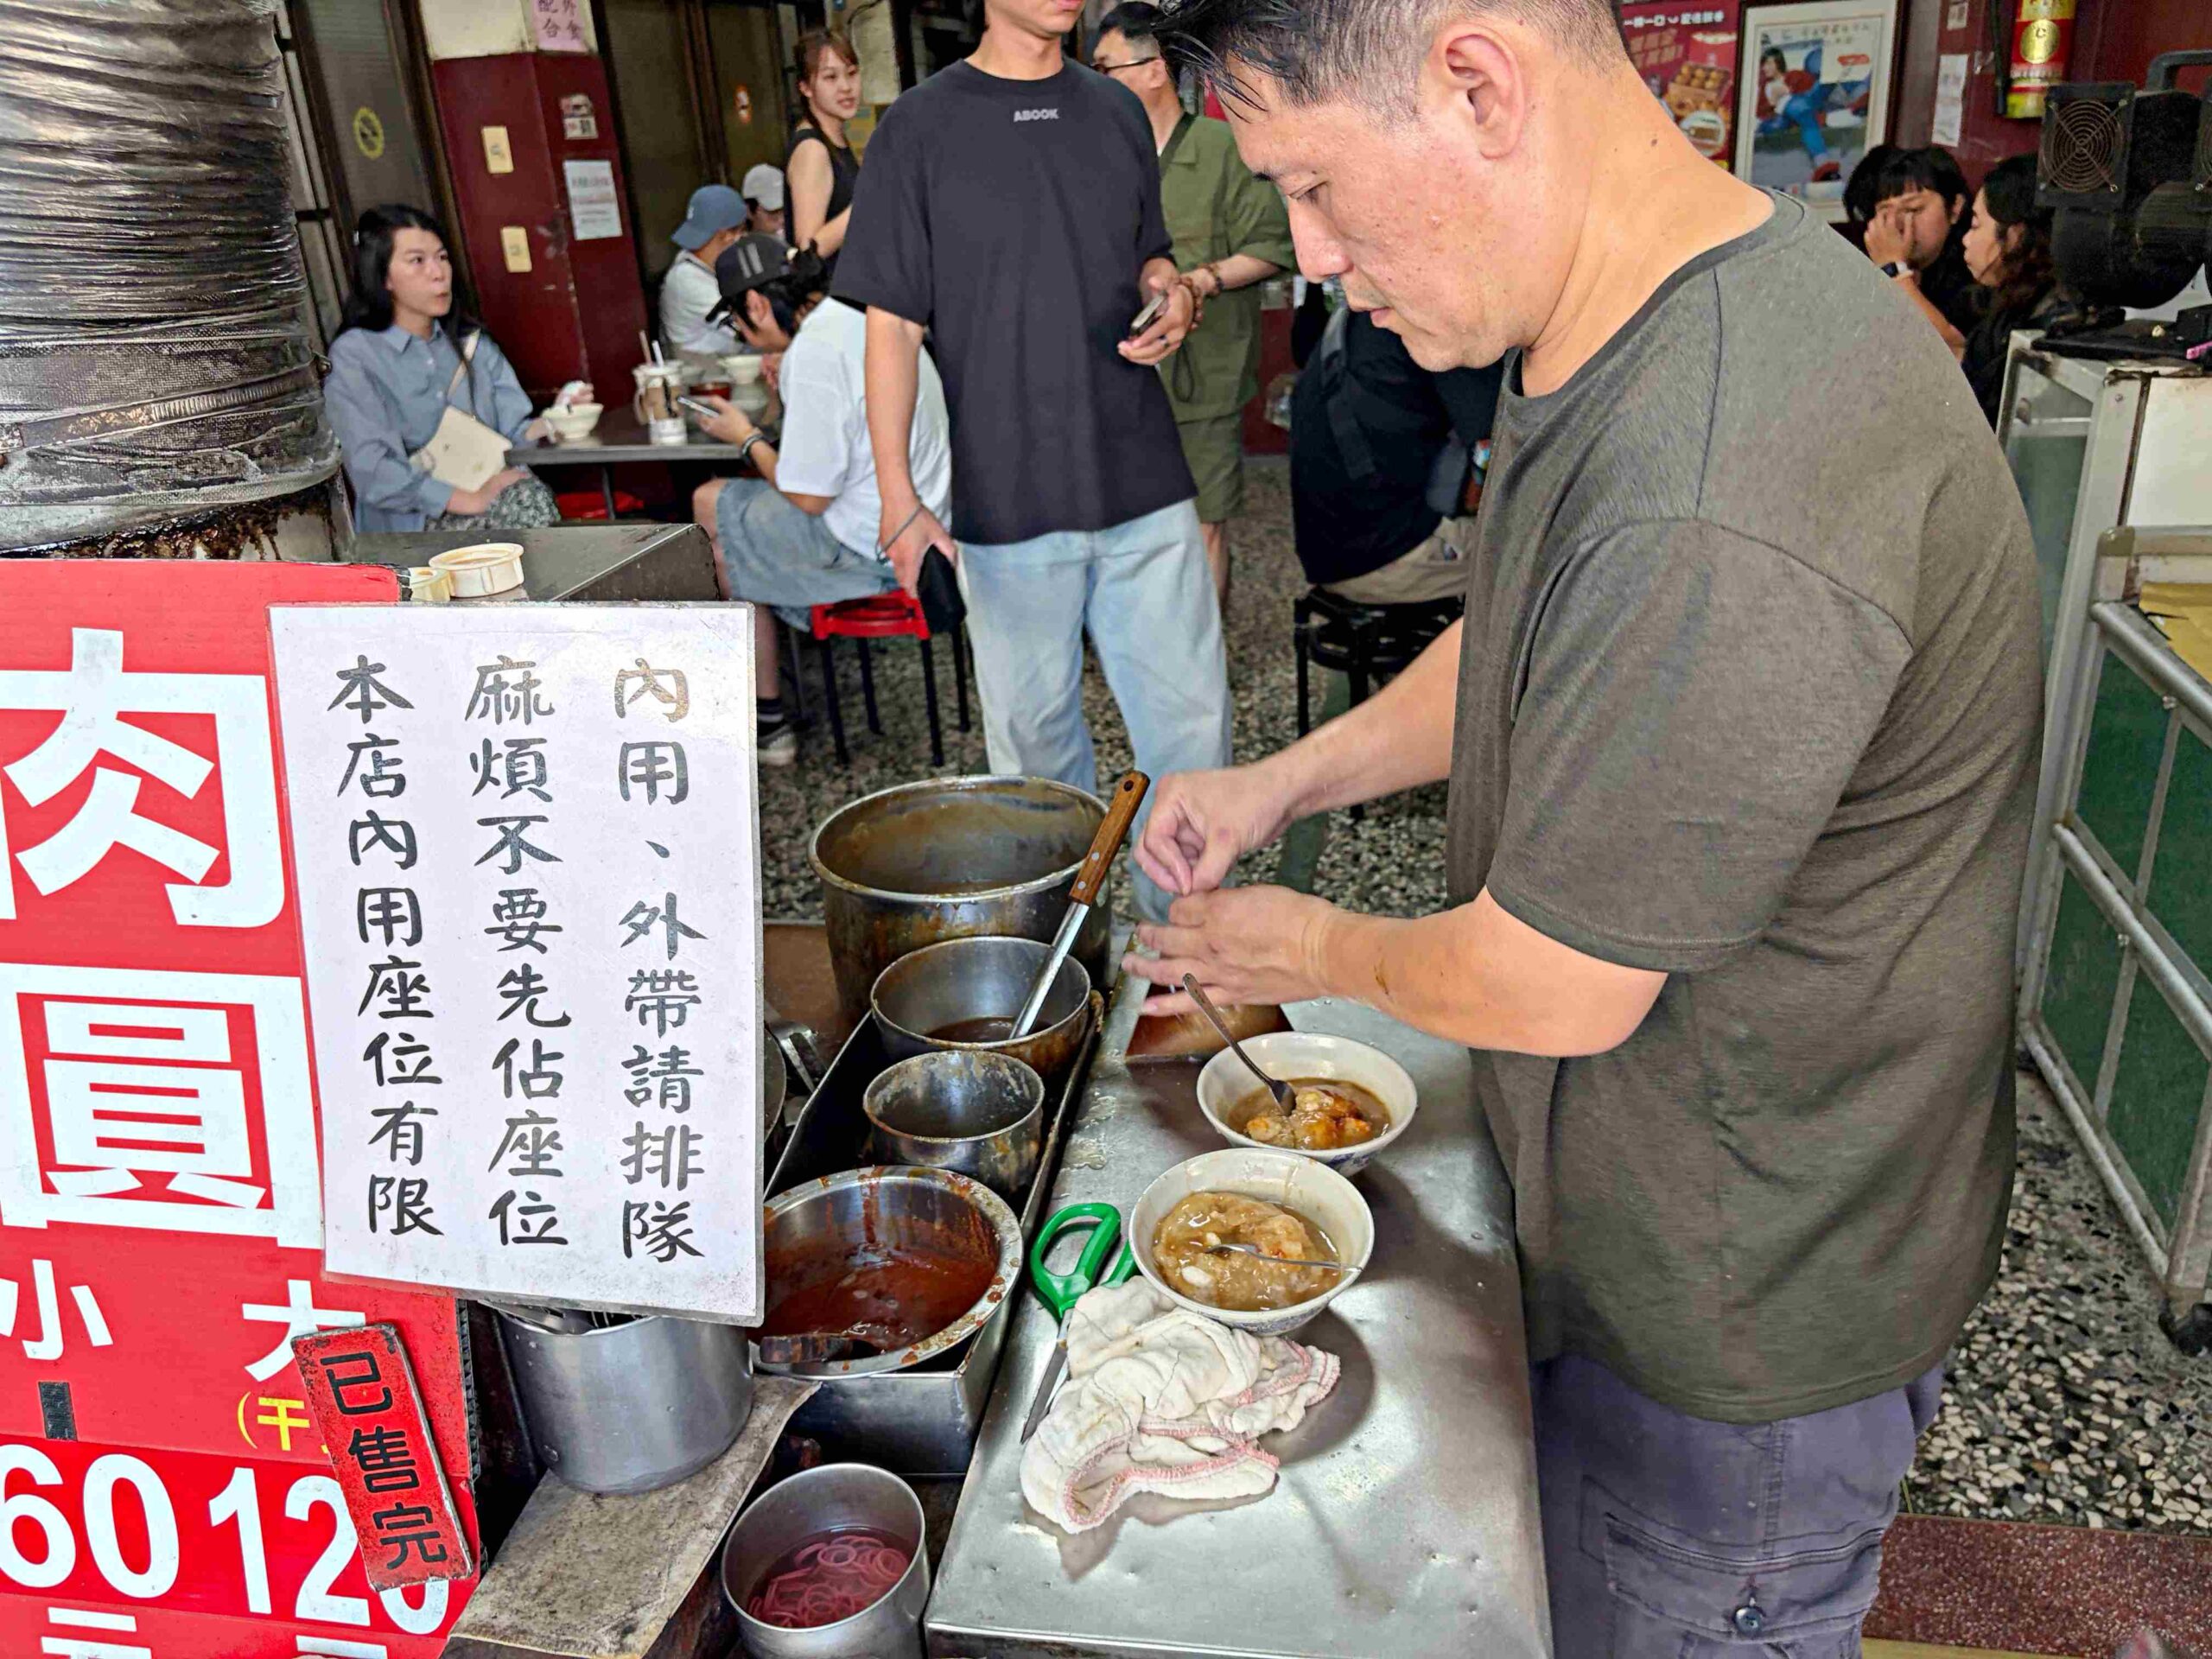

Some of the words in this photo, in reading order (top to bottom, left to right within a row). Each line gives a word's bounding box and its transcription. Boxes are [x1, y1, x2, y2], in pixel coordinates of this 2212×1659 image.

[1014, 108, 1059, 122] ABOOK
[464, 655, 572, 1247] 麻煩不要先佔座位
[0, 1259, 113, 1361] 小
[0, 1444, 180, 1599] 60
[319, 1351, 448, 1570] 已售完
